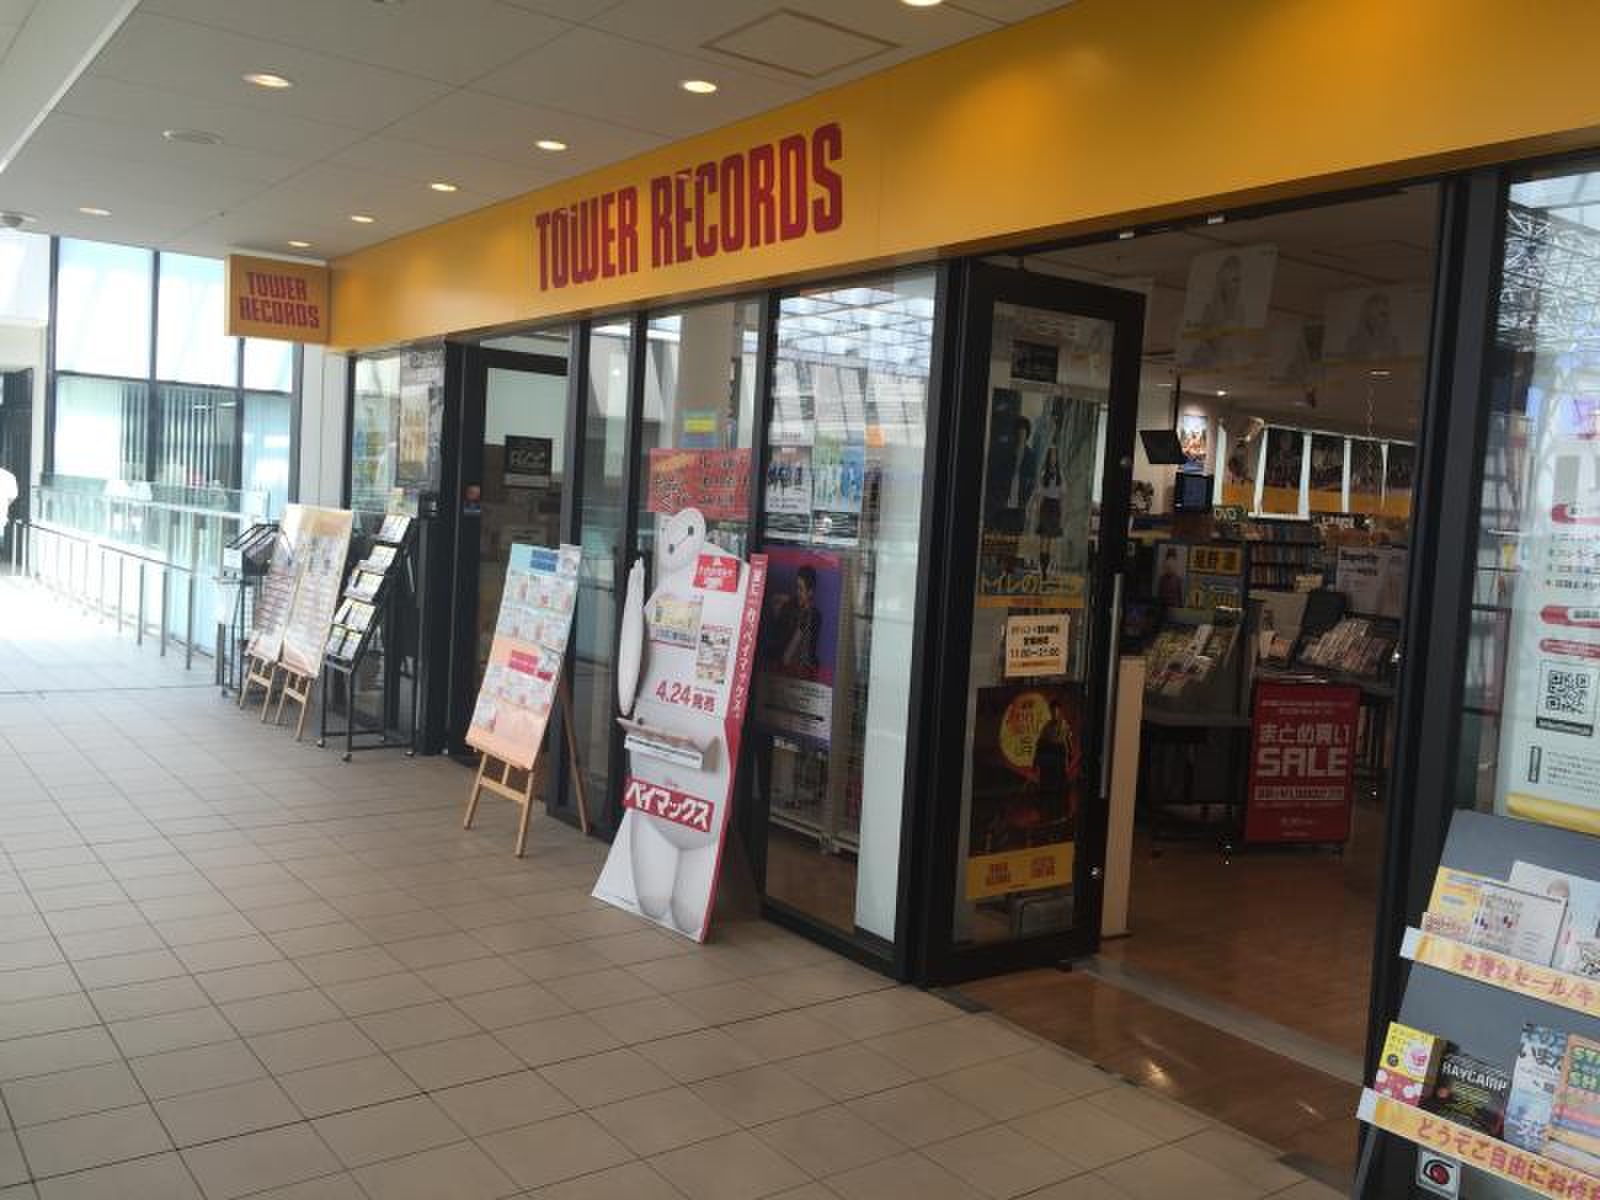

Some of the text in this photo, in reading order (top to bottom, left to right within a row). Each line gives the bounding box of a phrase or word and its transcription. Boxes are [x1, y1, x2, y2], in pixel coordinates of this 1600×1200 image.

[535, 122, 843, 291] TOWER RECORDS
[248, 271, 307, 299] TOWER
[239, 296, 320, 328] RECORDS
[1259, 722, 1350, 745] まとめ買い
[1255, 747, 1348, 777] SALE
[624, 781, 711, 832] ベイマックス
